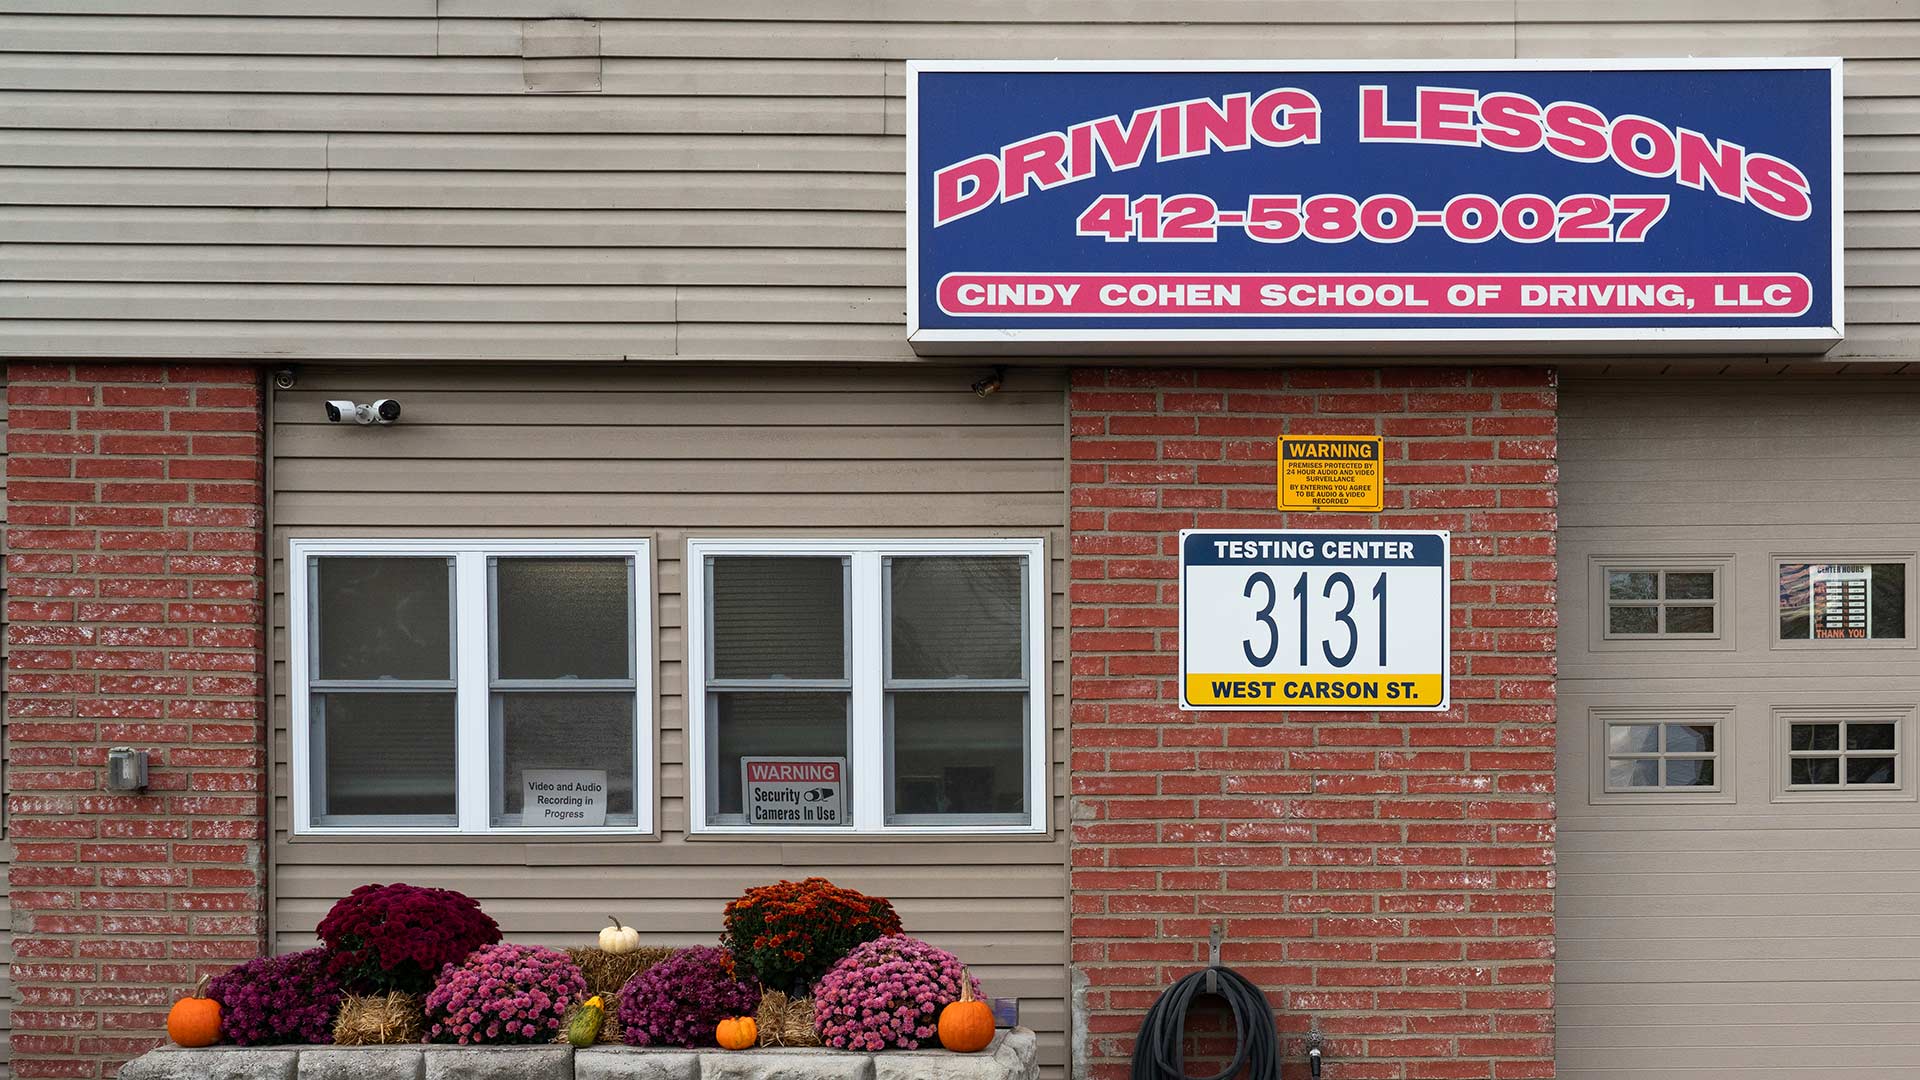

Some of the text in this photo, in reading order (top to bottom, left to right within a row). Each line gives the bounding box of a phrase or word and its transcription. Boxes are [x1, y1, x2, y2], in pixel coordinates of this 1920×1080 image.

[934, 85, 1812, 228] DRIVING LESSONS
[1076, 194, 1670, 244] 412-580-0027
[957, 284, 1792, 309] CINDY COHEN SCHOOL OF DRIVING, LLC
[1289, 443, 1372, 458] WARNING
[1214, 541, 1414, 559] TESTING CENTER
[1817, 565, 1864, 574] CENTER HOURS
[1243, 571, 1387, 668] 3131
[1816, 629, 1865, 638] THANK YOU
[1212, 682, 1419, 699] WEST CARSON ST.
[752, 765, 835, 780] WARNING
[528, 782, 602, 792] Video and Audio
[537, 795, 593, 807] Recording in
[754, 787, 800, 805] Security
[544, 809, 584, 820] Progress
[755, 805, 835, 820] Cameras In Use
